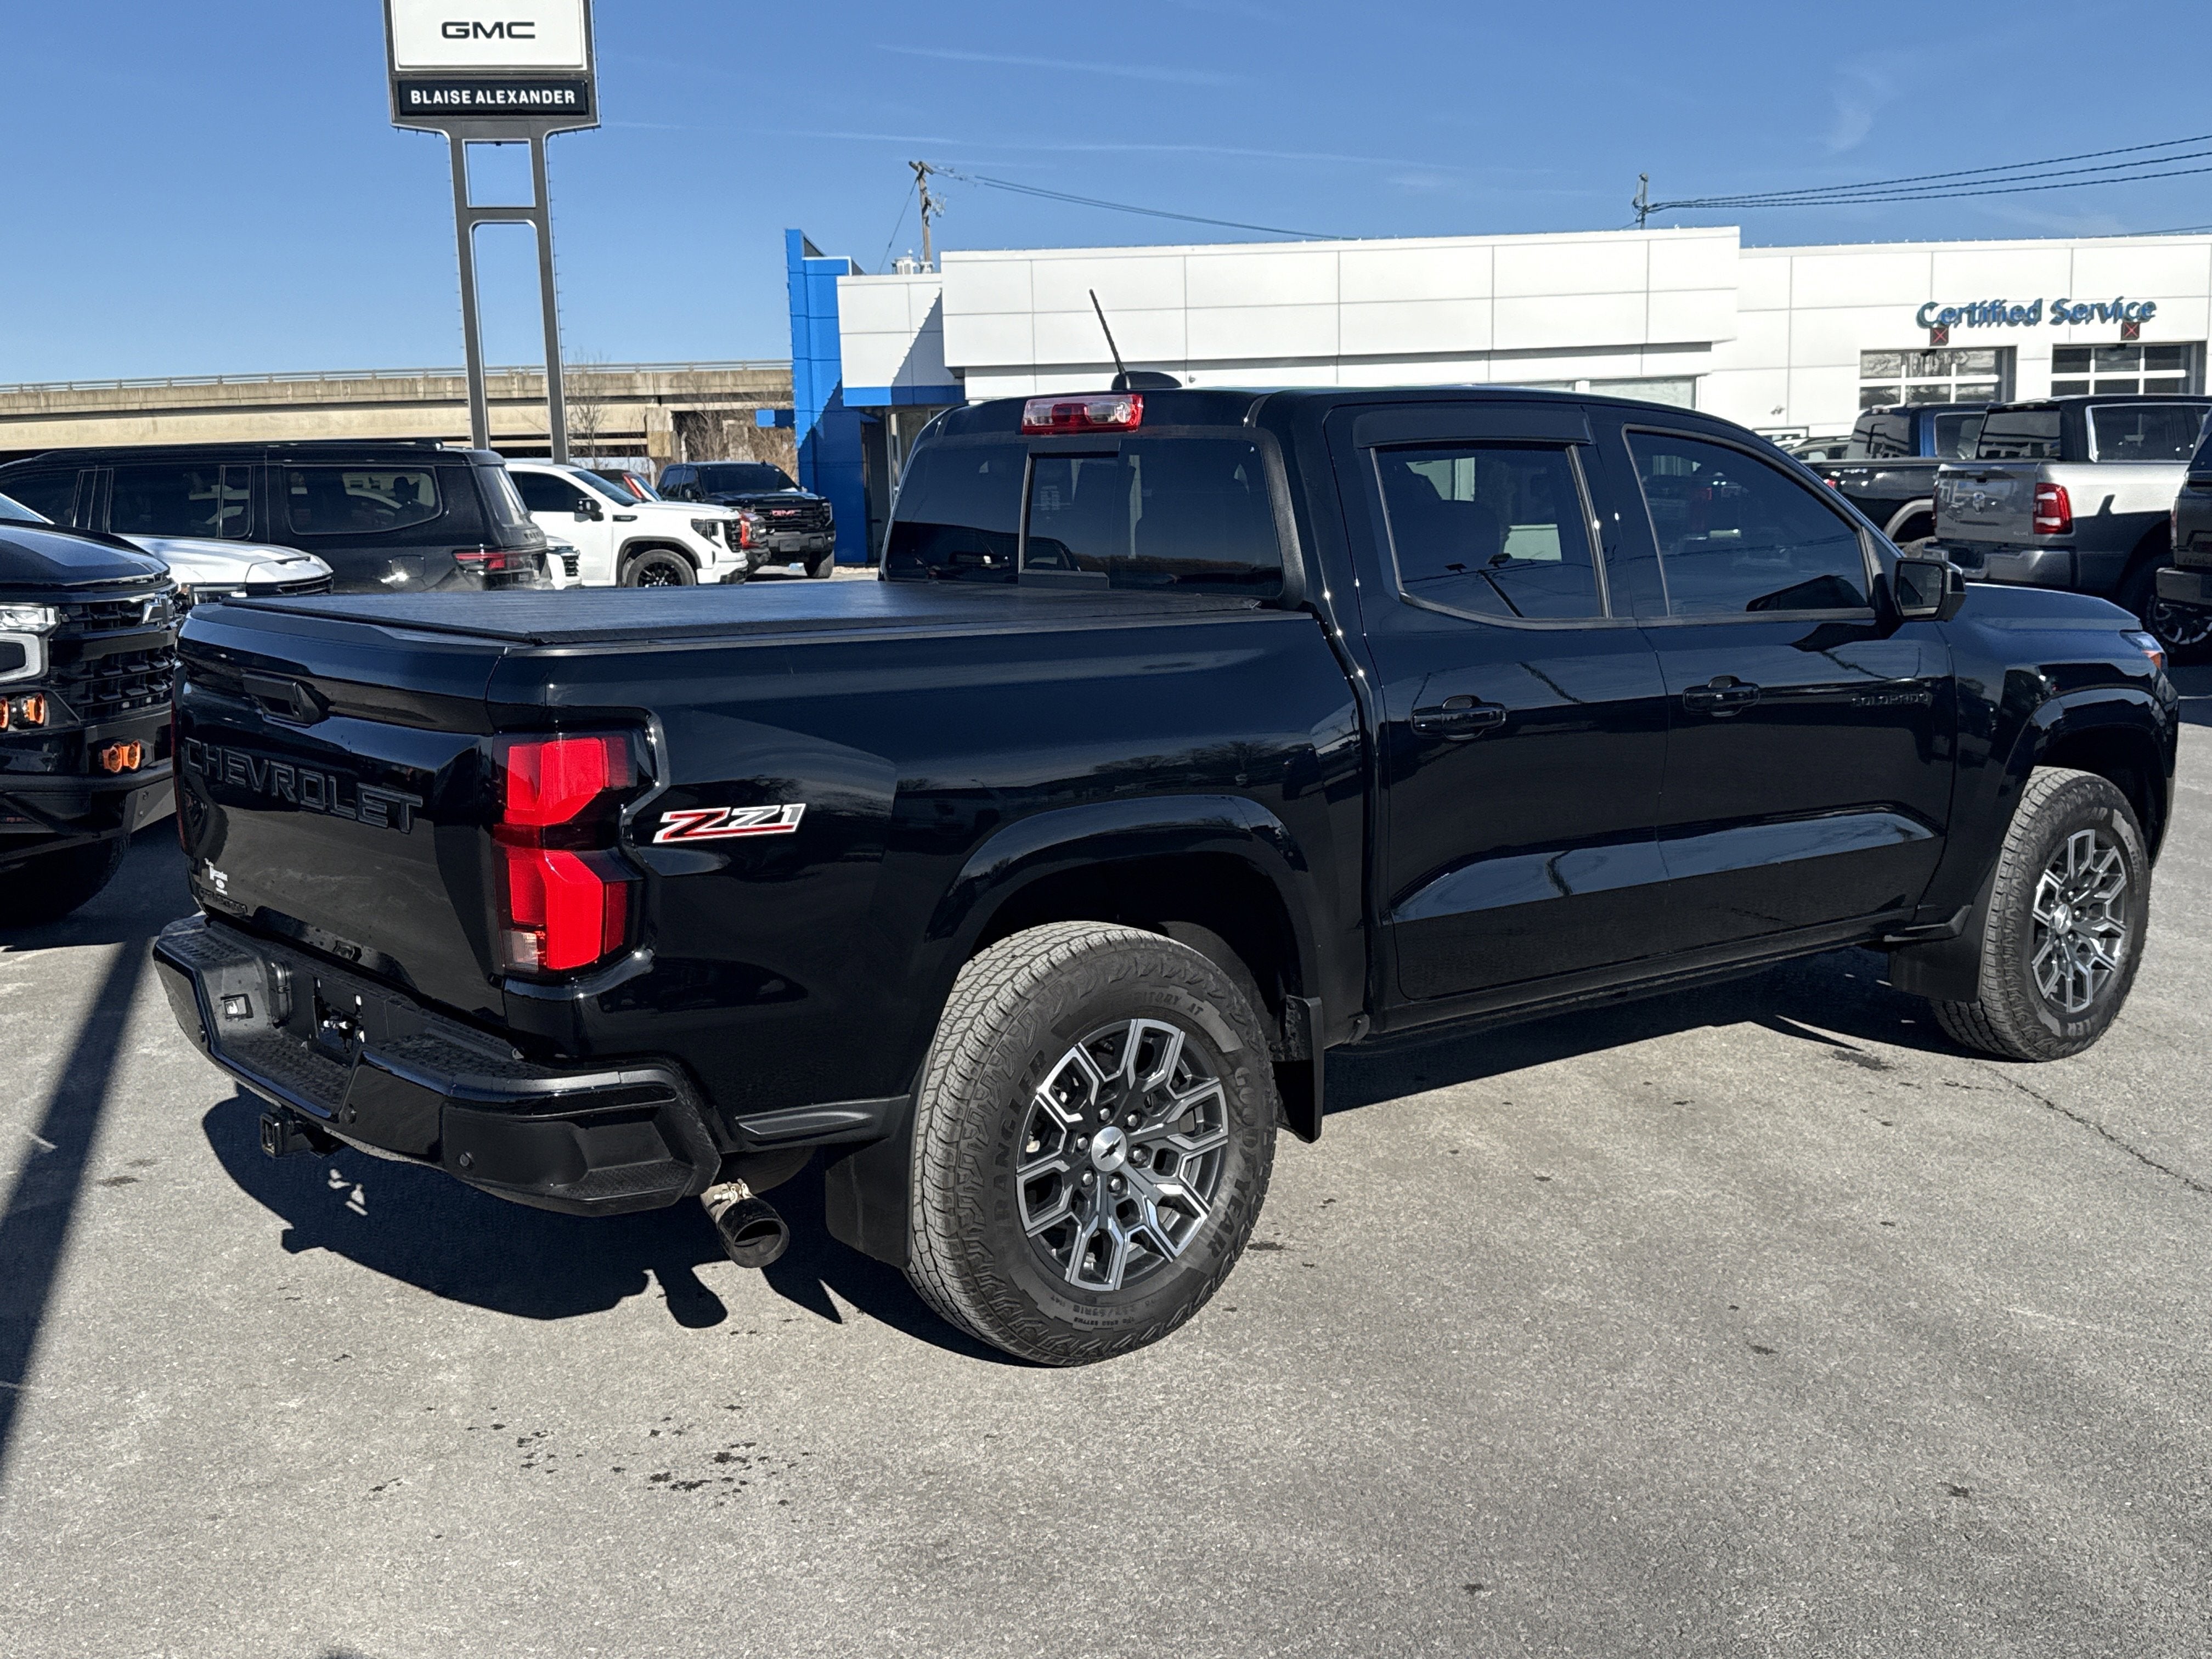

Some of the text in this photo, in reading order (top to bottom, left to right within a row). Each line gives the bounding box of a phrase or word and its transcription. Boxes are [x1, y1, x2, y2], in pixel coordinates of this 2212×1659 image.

[441, 21, 535, 39] GMC
[410, 90, 575, 104] BLAISE ALEXANDER
[1916, 296, 2157, 329] Certified Service
[181, 737, 423, 834] CHEVROLET
[652, 803, 806, 843] Z71
[994, 1048, 1050, 1241] RANGLER
